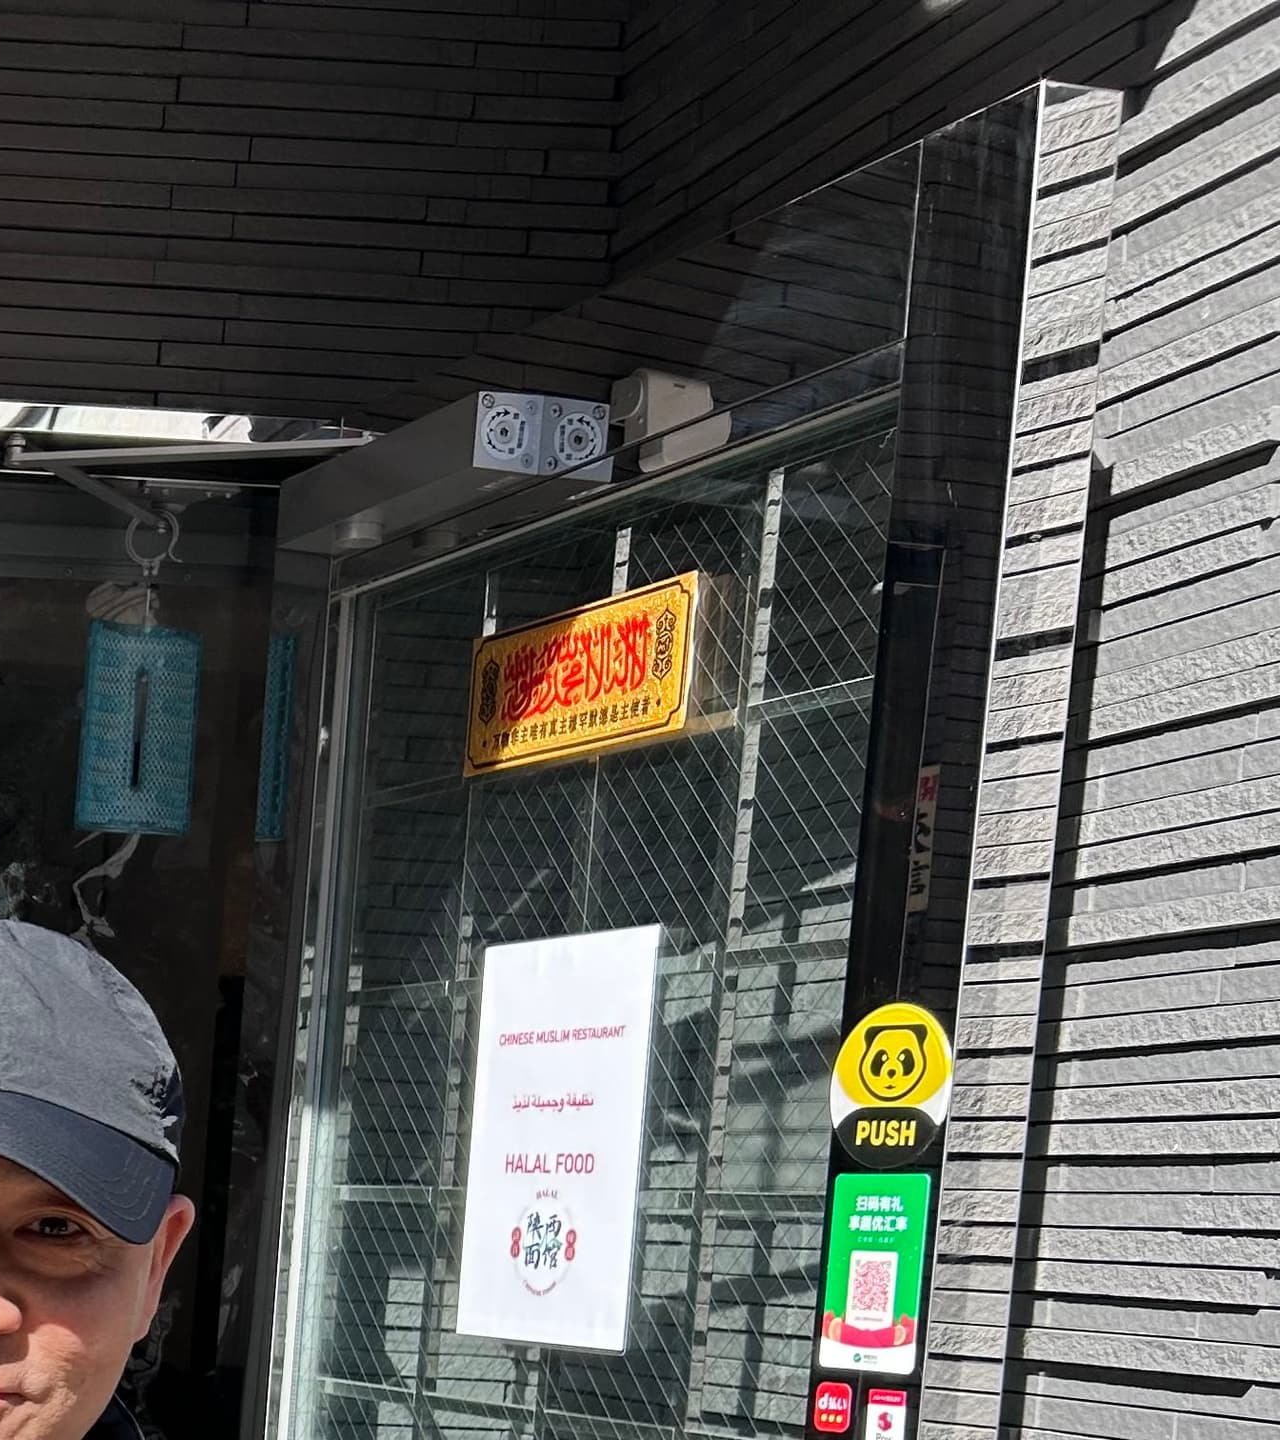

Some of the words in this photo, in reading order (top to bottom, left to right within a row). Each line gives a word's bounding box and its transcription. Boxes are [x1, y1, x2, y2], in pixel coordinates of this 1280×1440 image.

[499, 1031, 535, 1046] CHINESE
[536, 1029, 570, 1044] MUSLIM
[572, 1025, 626, 1041] RESTAURANT
[855, 1119, 917, 1147] PUSH
[505, 1153, 551, 1174] HALAL
[555, 1153, 595, 1174] FOOD
